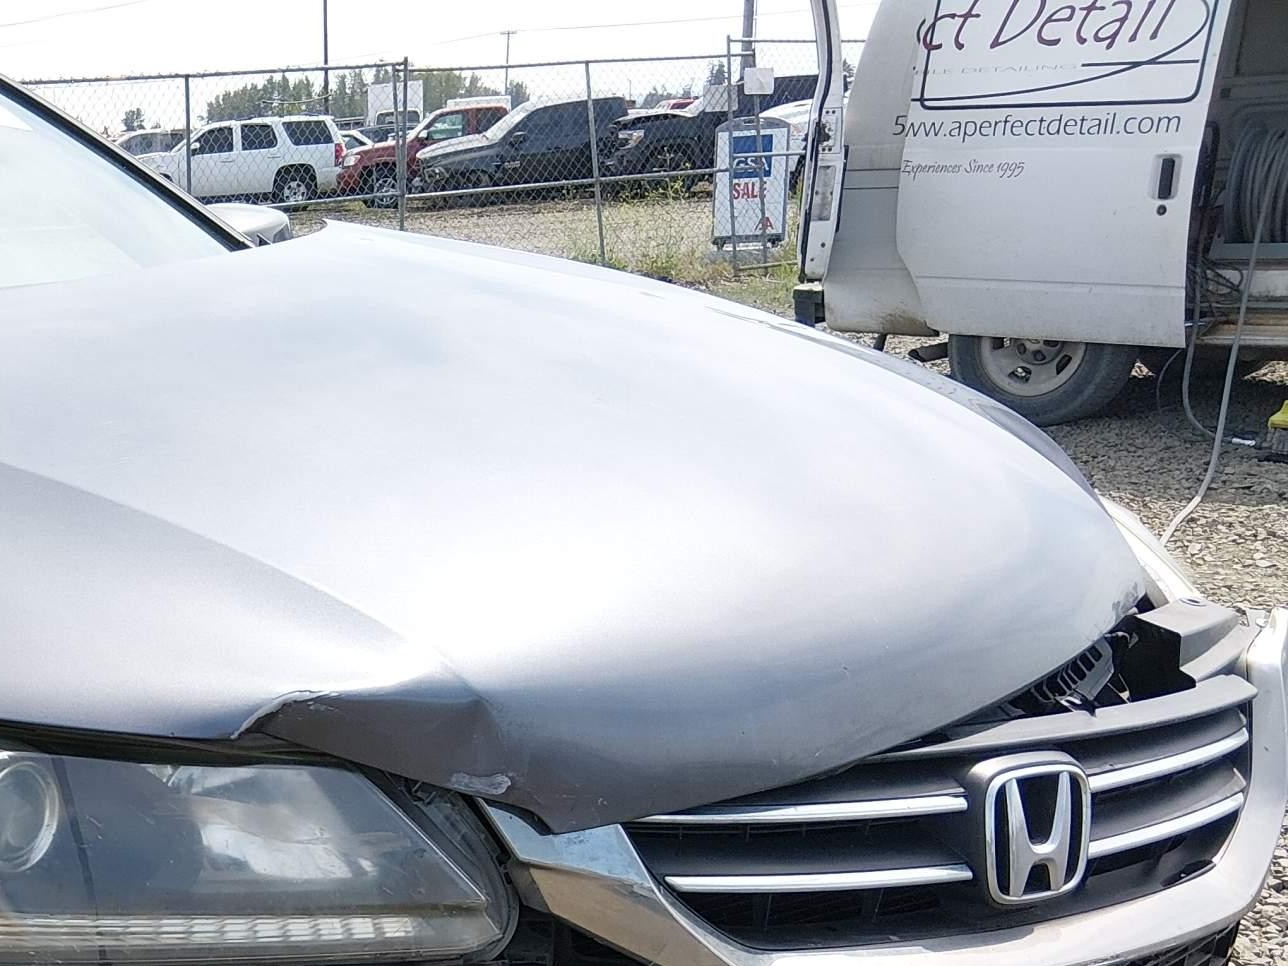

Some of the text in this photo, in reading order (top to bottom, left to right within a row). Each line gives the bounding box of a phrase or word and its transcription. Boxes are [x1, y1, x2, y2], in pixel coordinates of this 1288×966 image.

[989, 0, 1176, 50] Detail
[901, 158, 1025, 181] Experiences Since 1995
